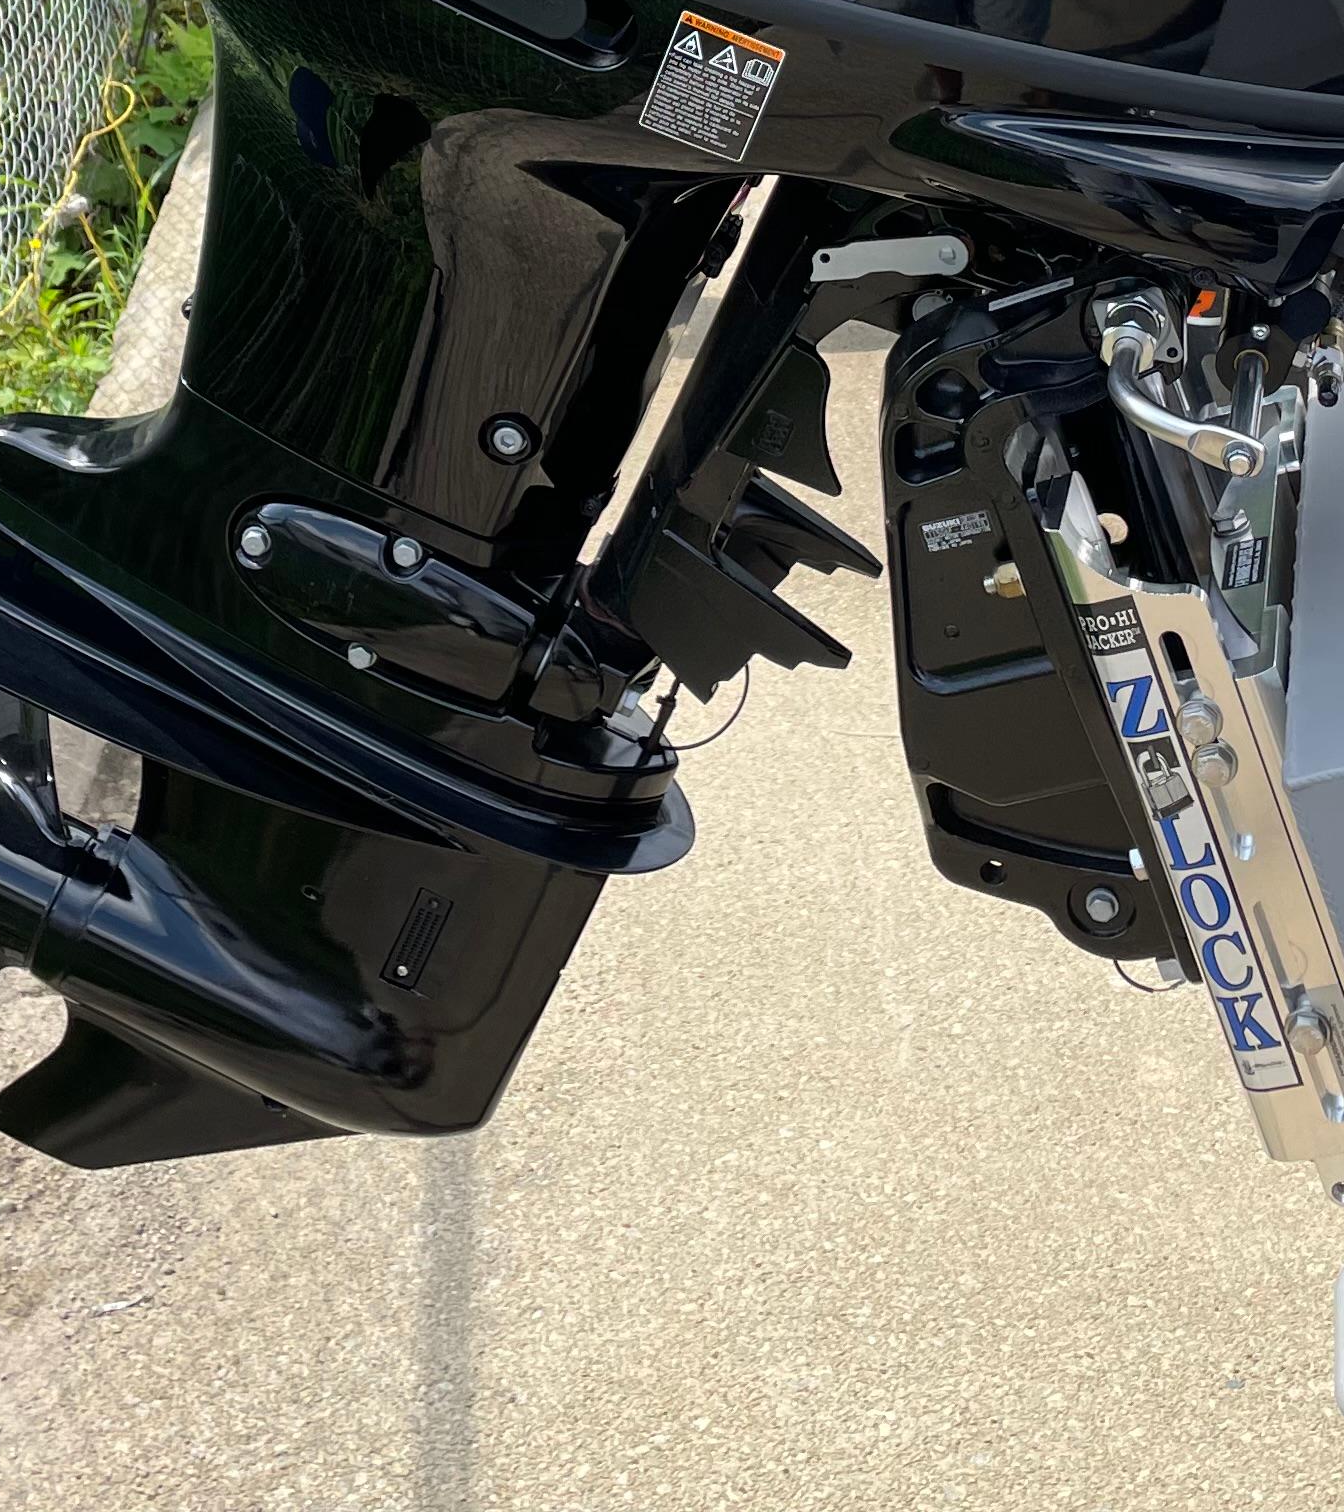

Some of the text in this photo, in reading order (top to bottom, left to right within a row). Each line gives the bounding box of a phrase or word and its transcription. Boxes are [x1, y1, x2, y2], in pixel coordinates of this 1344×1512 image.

[694, 19, 731, 39] WARNING
[1106, 674, 1169, 739] Z
[1158, 815, 1282, 1053] LOCK
